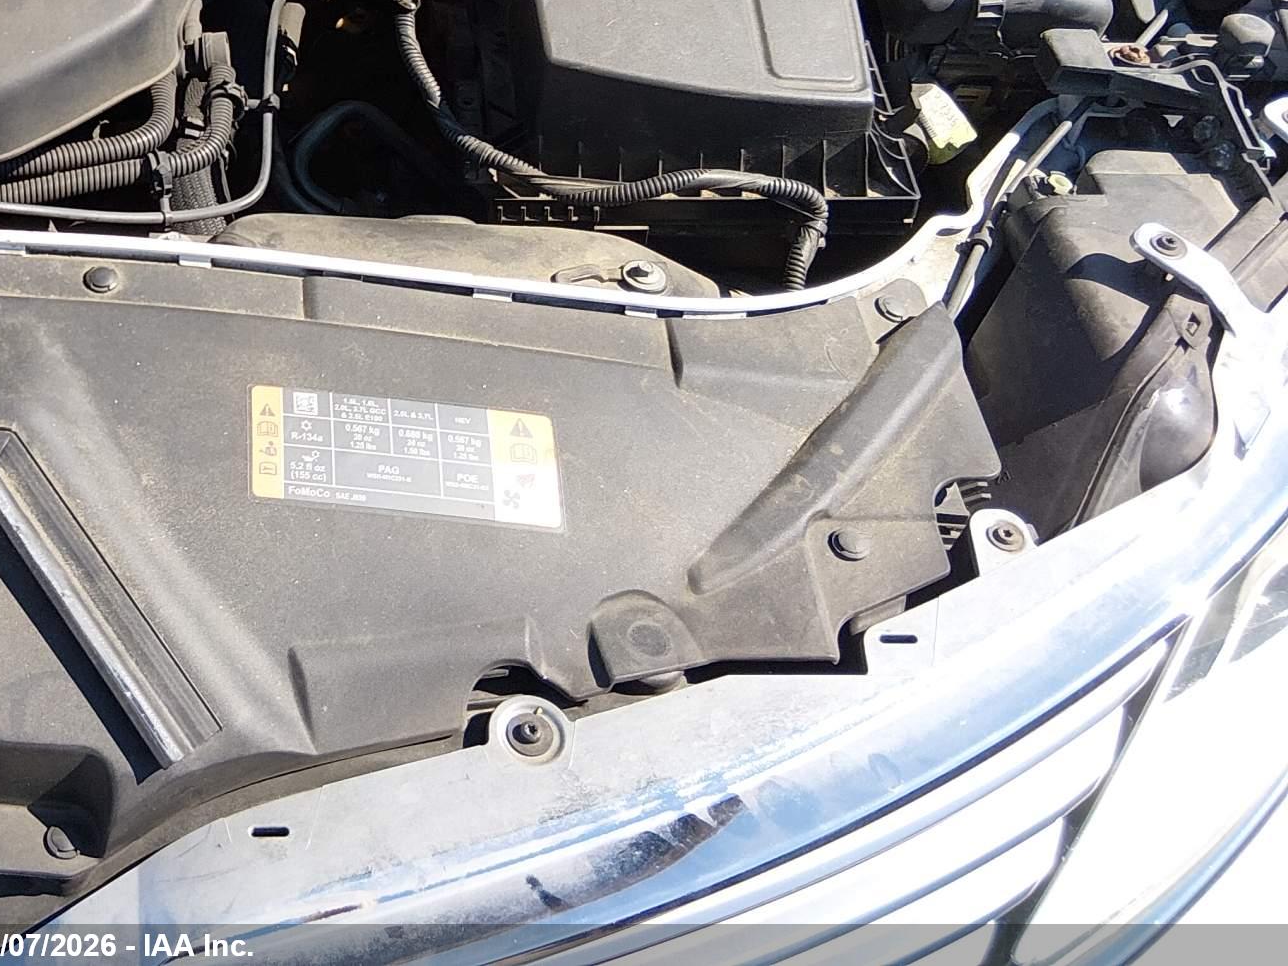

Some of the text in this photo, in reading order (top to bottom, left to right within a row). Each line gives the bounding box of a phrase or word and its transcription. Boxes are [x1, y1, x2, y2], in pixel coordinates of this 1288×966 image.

[290, 431, 324, 442] R-134a
[368, 426, 380, 436] kg
[422, 431, 433, 442] kg
[470, 437, 482, 448] kg
[290, 461, 304, 470] 5.2
[314, 464, 326, 472] oz
[378, 464, 400, 474] PAG
[290, 470, 326, 482] (155 cc)
[456, 473, 479, 483] POE
[288, 486, 330, 498] FoMoCo
[336, 492, 350, 500] SAE
